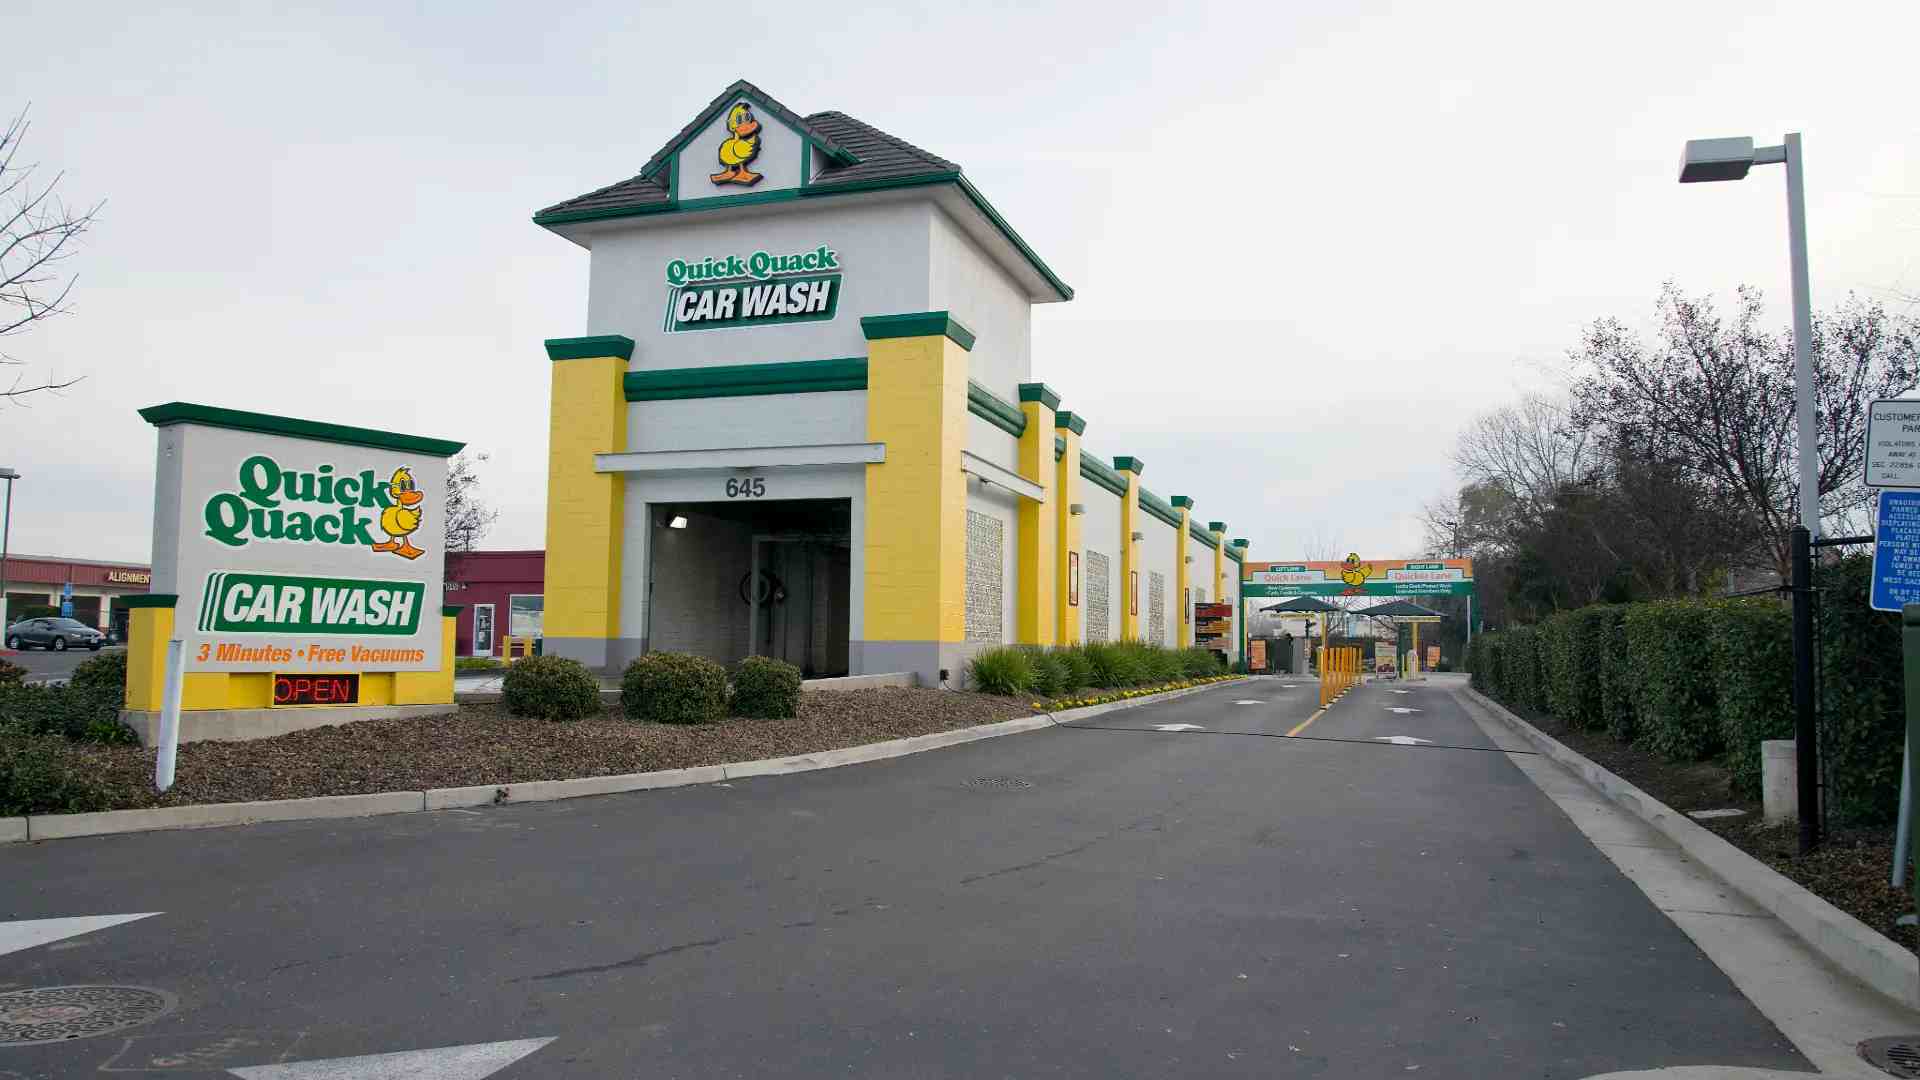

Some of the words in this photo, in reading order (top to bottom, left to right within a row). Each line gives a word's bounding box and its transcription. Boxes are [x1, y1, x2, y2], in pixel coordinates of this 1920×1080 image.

[666, 255, 746, 286] Quick
[749, 246, 838, 279] Quack
[676, 287, 738, 322] CAR
[741, 279, 832, 318] WASH
[239, 455, 393, 508] Quick
[726, 477, 766, 498] 645
[205, 493, 376, 547] Quack
[223, 582, 306, 624] CAR
[310, 587, 416, 627] WASH
[196, 643, 211, 662] 3
[215, 643, 293, 662] Minutes
[306, 644, 346, 663] Free
[350, 645, 425, 663] Vacuums
[275, 677, 349, 702] OPEN
